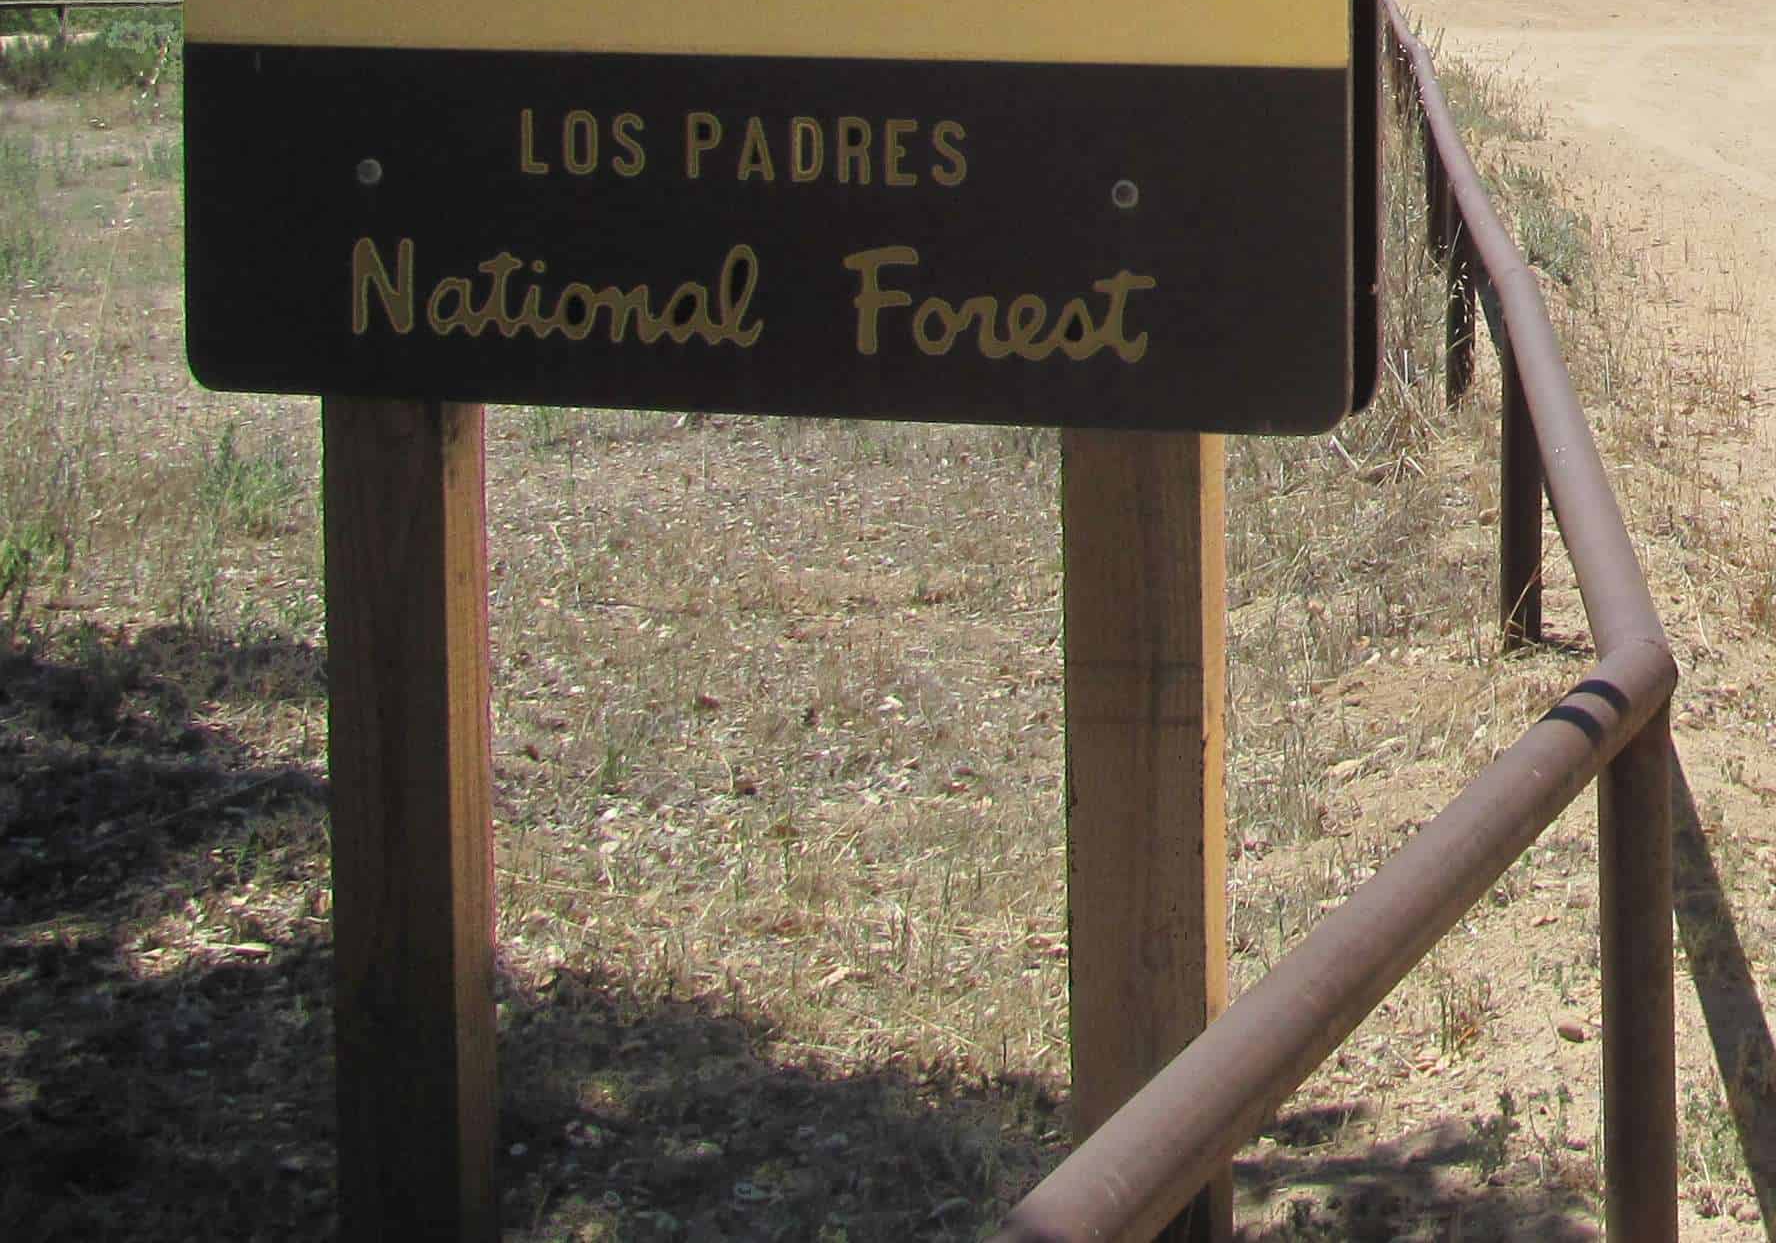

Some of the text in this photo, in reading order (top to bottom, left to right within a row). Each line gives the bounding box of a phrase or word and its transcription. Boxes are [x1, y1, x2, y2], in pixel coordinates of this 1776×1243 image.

[520, 107, 968, 187] LOS PADRES
[352, 237, 1156, 363] National Forest
